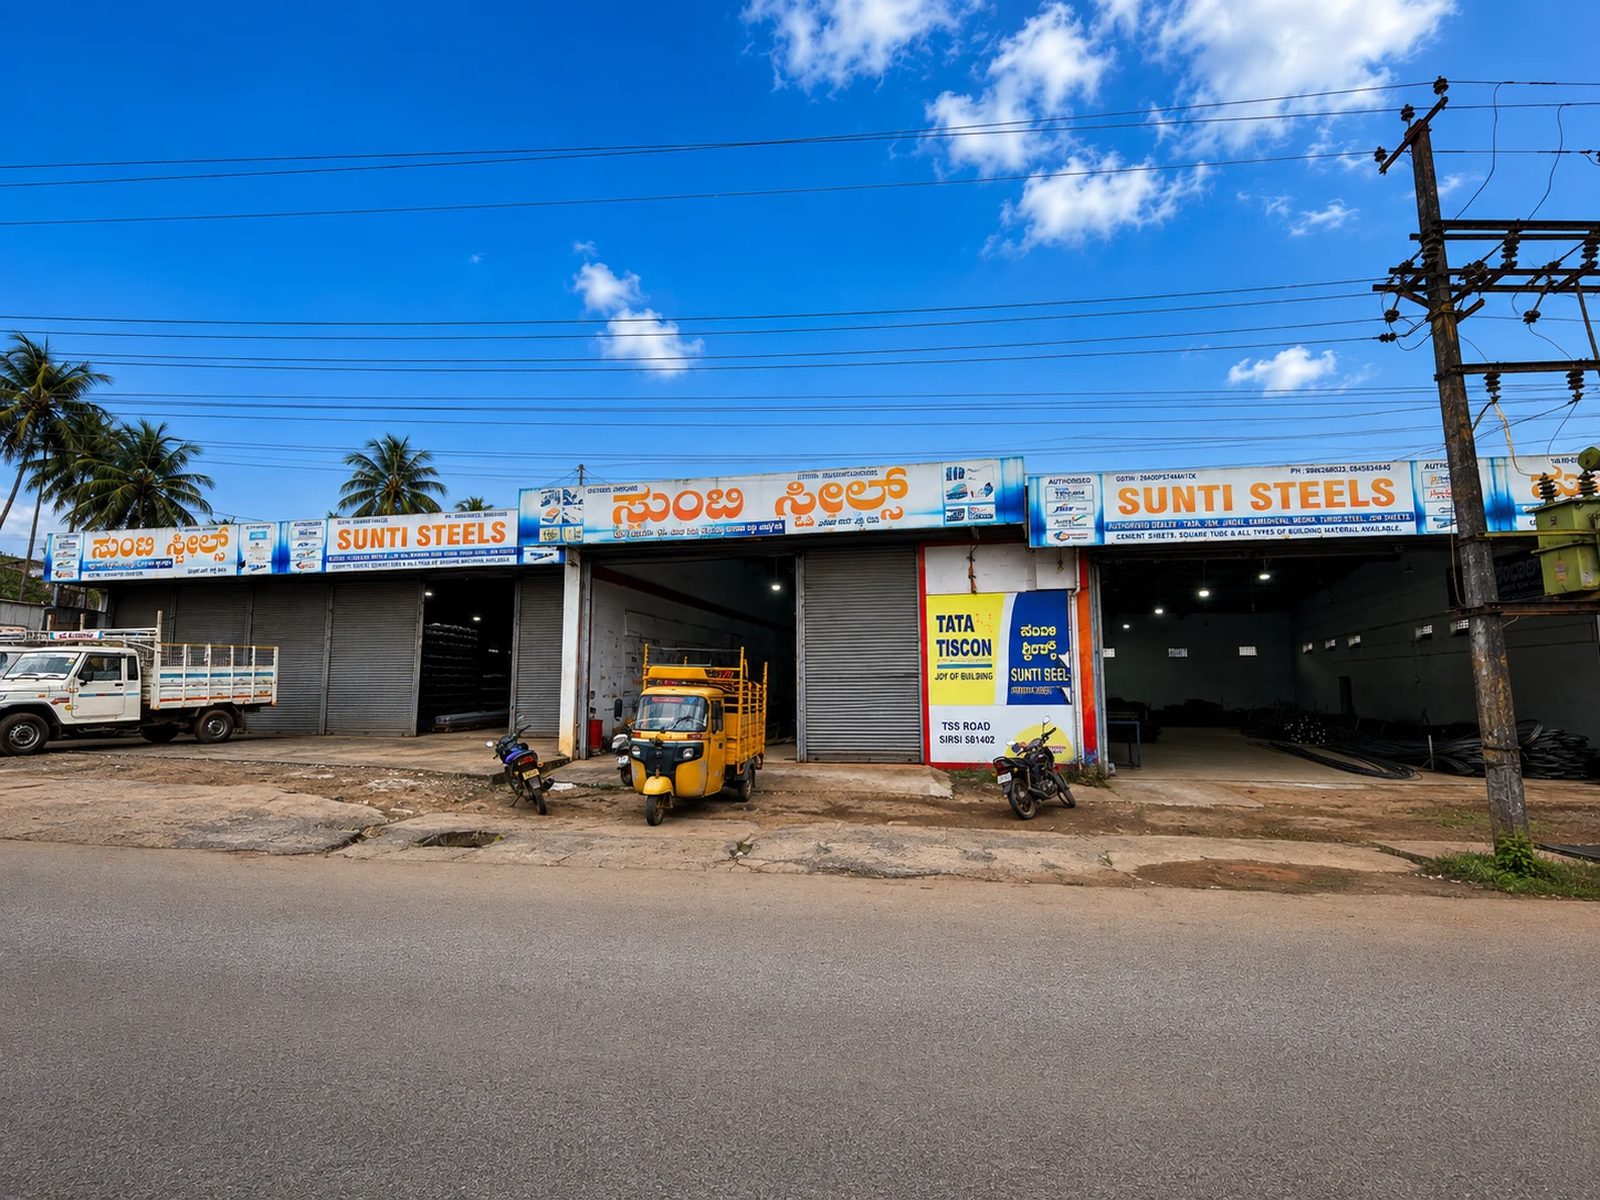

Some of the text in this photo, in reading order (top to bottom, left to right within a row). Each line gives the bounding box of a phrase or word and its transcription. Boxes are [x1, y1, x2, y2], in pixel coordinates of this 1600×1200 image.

[1118, 477, 1395, 515] SUNTI STEELS
[337, 521, 506, 550] SUNTI STEELS
[936, 614, 975, 633] TATA
[936, 638, 992, 657] TISCON
[935, 672, 948, 680] JOY
[949, 672, 959, 680] OF
[1010, 667, 1041, 681] SUNTI
[941, 721, 991, 731] TSS ROAD
[939, 735, 962, 744] SIRSI
